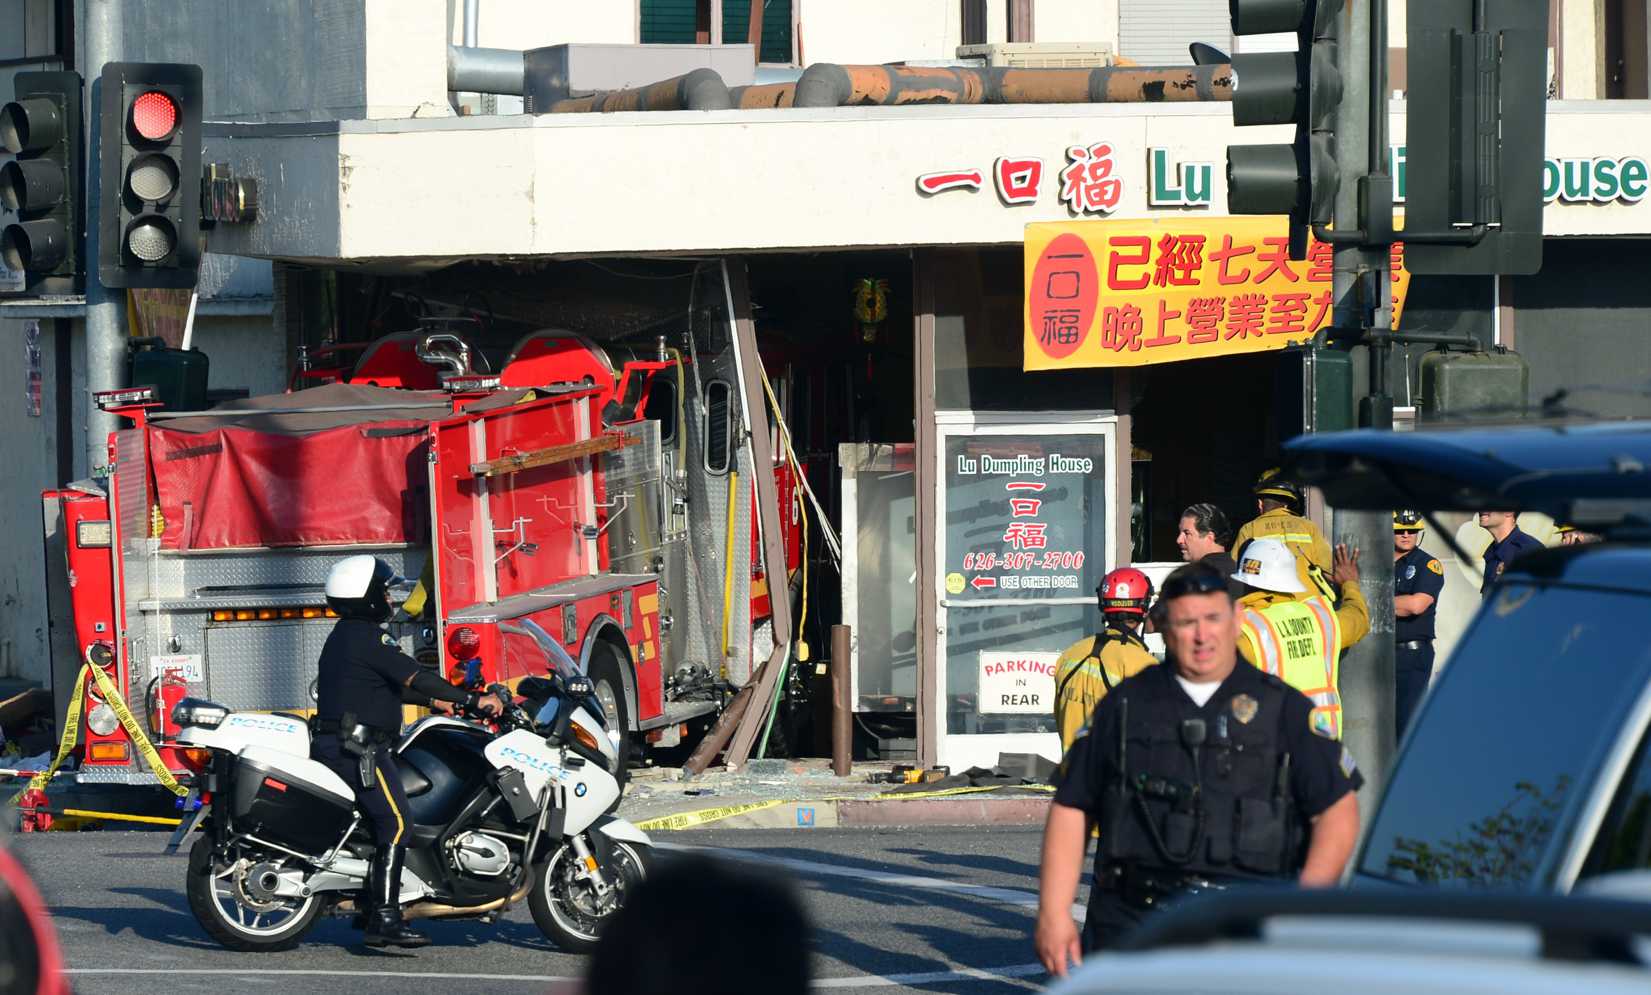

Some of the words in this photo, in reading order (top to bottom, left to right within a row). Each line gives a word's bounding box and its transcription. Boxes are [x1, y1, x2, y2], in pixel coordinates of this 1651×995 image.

[919, 143, 1124, 211] 一口福
[1152, 148, 1213, 204] Lu
[1543, 157, 1649, 200] ouse
[1040, 252, 1085, 347] 一口福
[958, 455, 977, 475] Lu
[981, 455, 1046, 477] Dumpling
[1049, 454, 1094, 474] House
[1003, 482, 1048, 550] 一口福
[963, 551, 1086, 571] 626-307-2700
[1000, 576, 1020, 589] USE
[1021, 576, 1051, 588] OTHER
[1052, 575, 1079, 588] DOOR
[984, 659, 1056, 677] PARKING
[1015, 679, 1027, 687] IN
[1001, 694, 1040, 706] REAR
[230, 716, 298, 734] POLICE
[499, 746, 571, 781] POLICE
